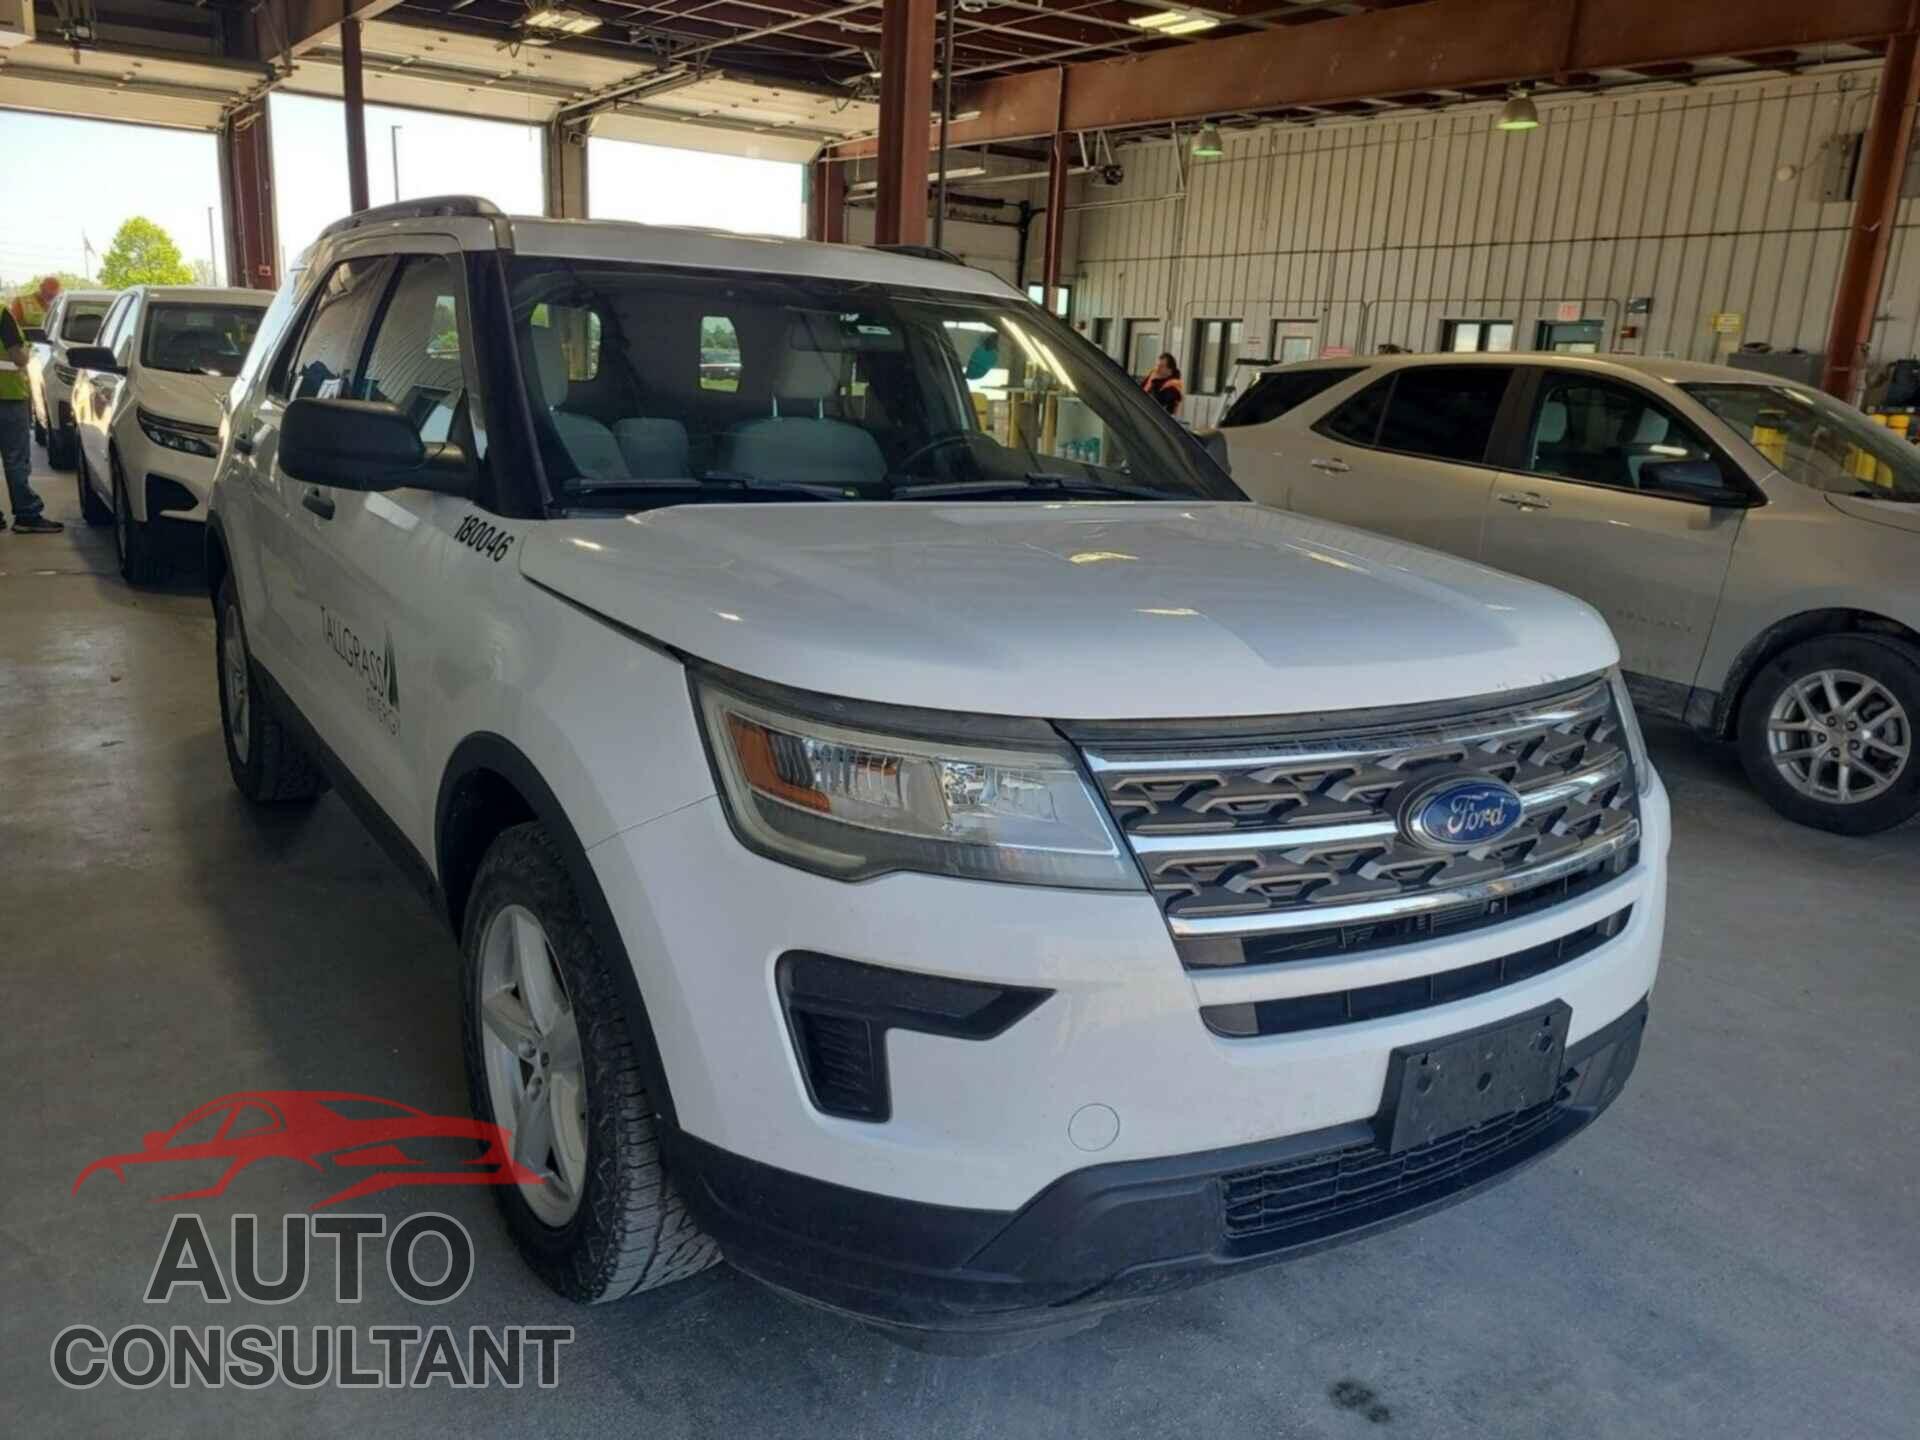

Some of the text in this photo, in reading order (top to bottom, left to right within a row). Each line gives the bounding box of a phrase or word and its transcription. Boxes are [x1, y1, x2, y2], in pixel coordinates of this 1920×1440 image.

[454, 514, 515, 562] 180046
[320, 604, 384, 697] TALLGRASS
[1447, 792, 1506, 833] Ford
